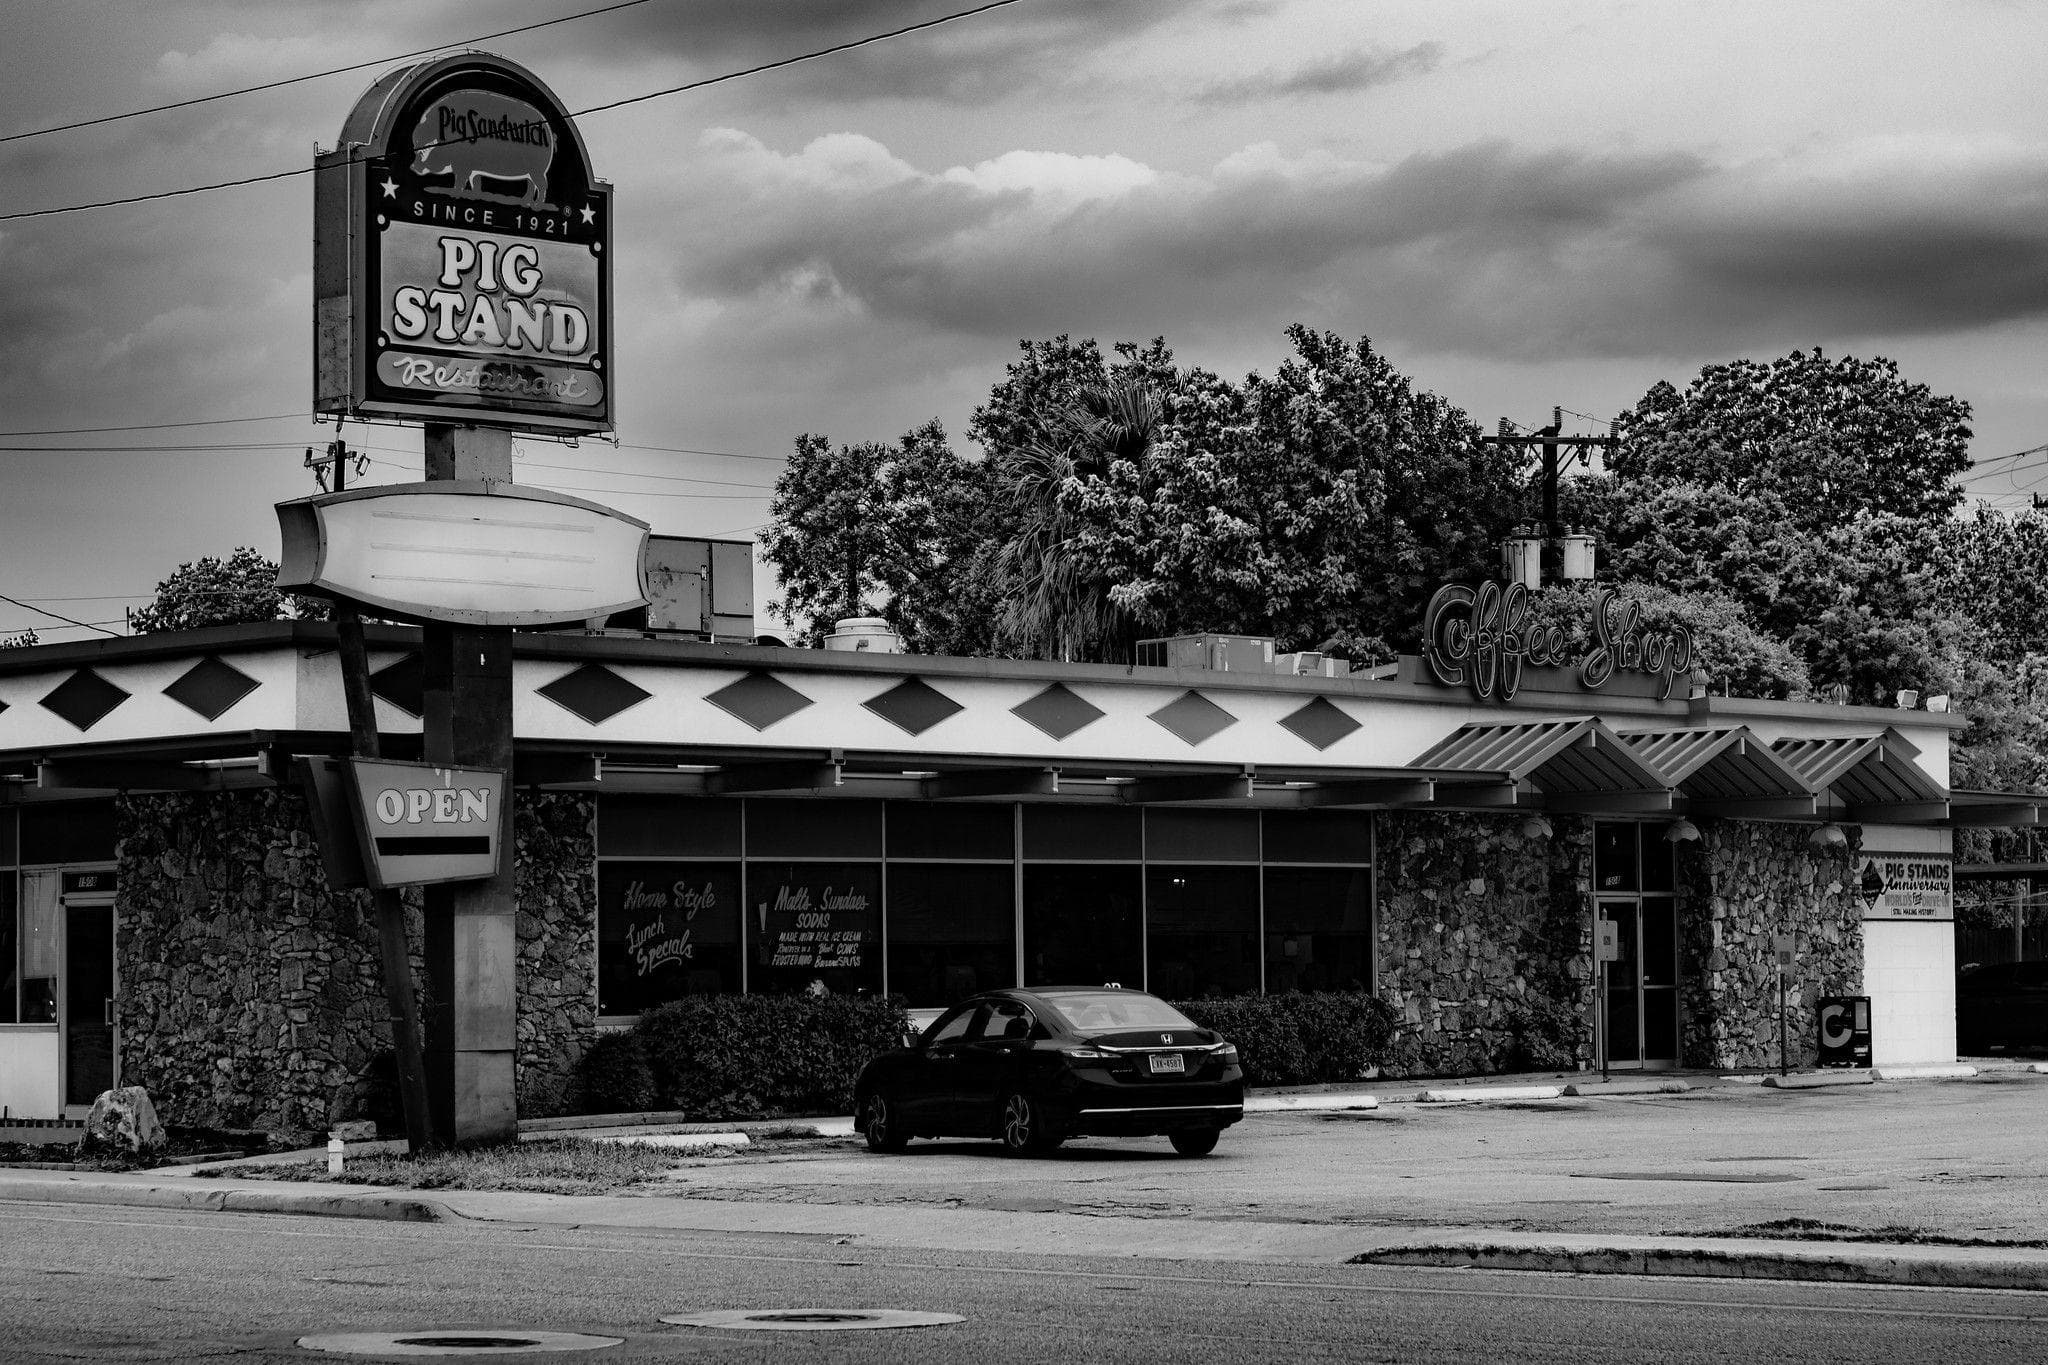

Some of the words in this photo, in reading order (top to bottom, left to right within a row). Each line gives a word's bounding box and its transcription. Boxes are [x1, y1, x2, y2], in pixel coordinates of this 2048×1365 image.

[413, 201, 494, 226] SINCE
[515, 214, 569, 236] 1921
[438, 236, 543, 298] PIG
[393, 285, 589, 355] STAND
[393, 356, 589, 400] Restaurant
[1423, 580, 1566, 701] Coffee
[1579, 588, 1692, 701] Shop
[376, 788, 491, 825] OPEN
[1880, 877, 1950, 896] Anniversary
[1885, 863, 1905, 879] PIG
[1907, 864, 1950, 879] STANDS
[624, 880, 668, 910] Home
[672, 880, 717, 921] Style
[820, 886, 870, 911] Sundaes
[625, 914, 666, 955] Lunch
[779, 931, 799, 943] MADE
[815, 931, 830, 942] REAL
[796, 913, 831, 928] SODAS
[637, 929, 693, 977] Specials
[837, 943, 859, 955] COWS
